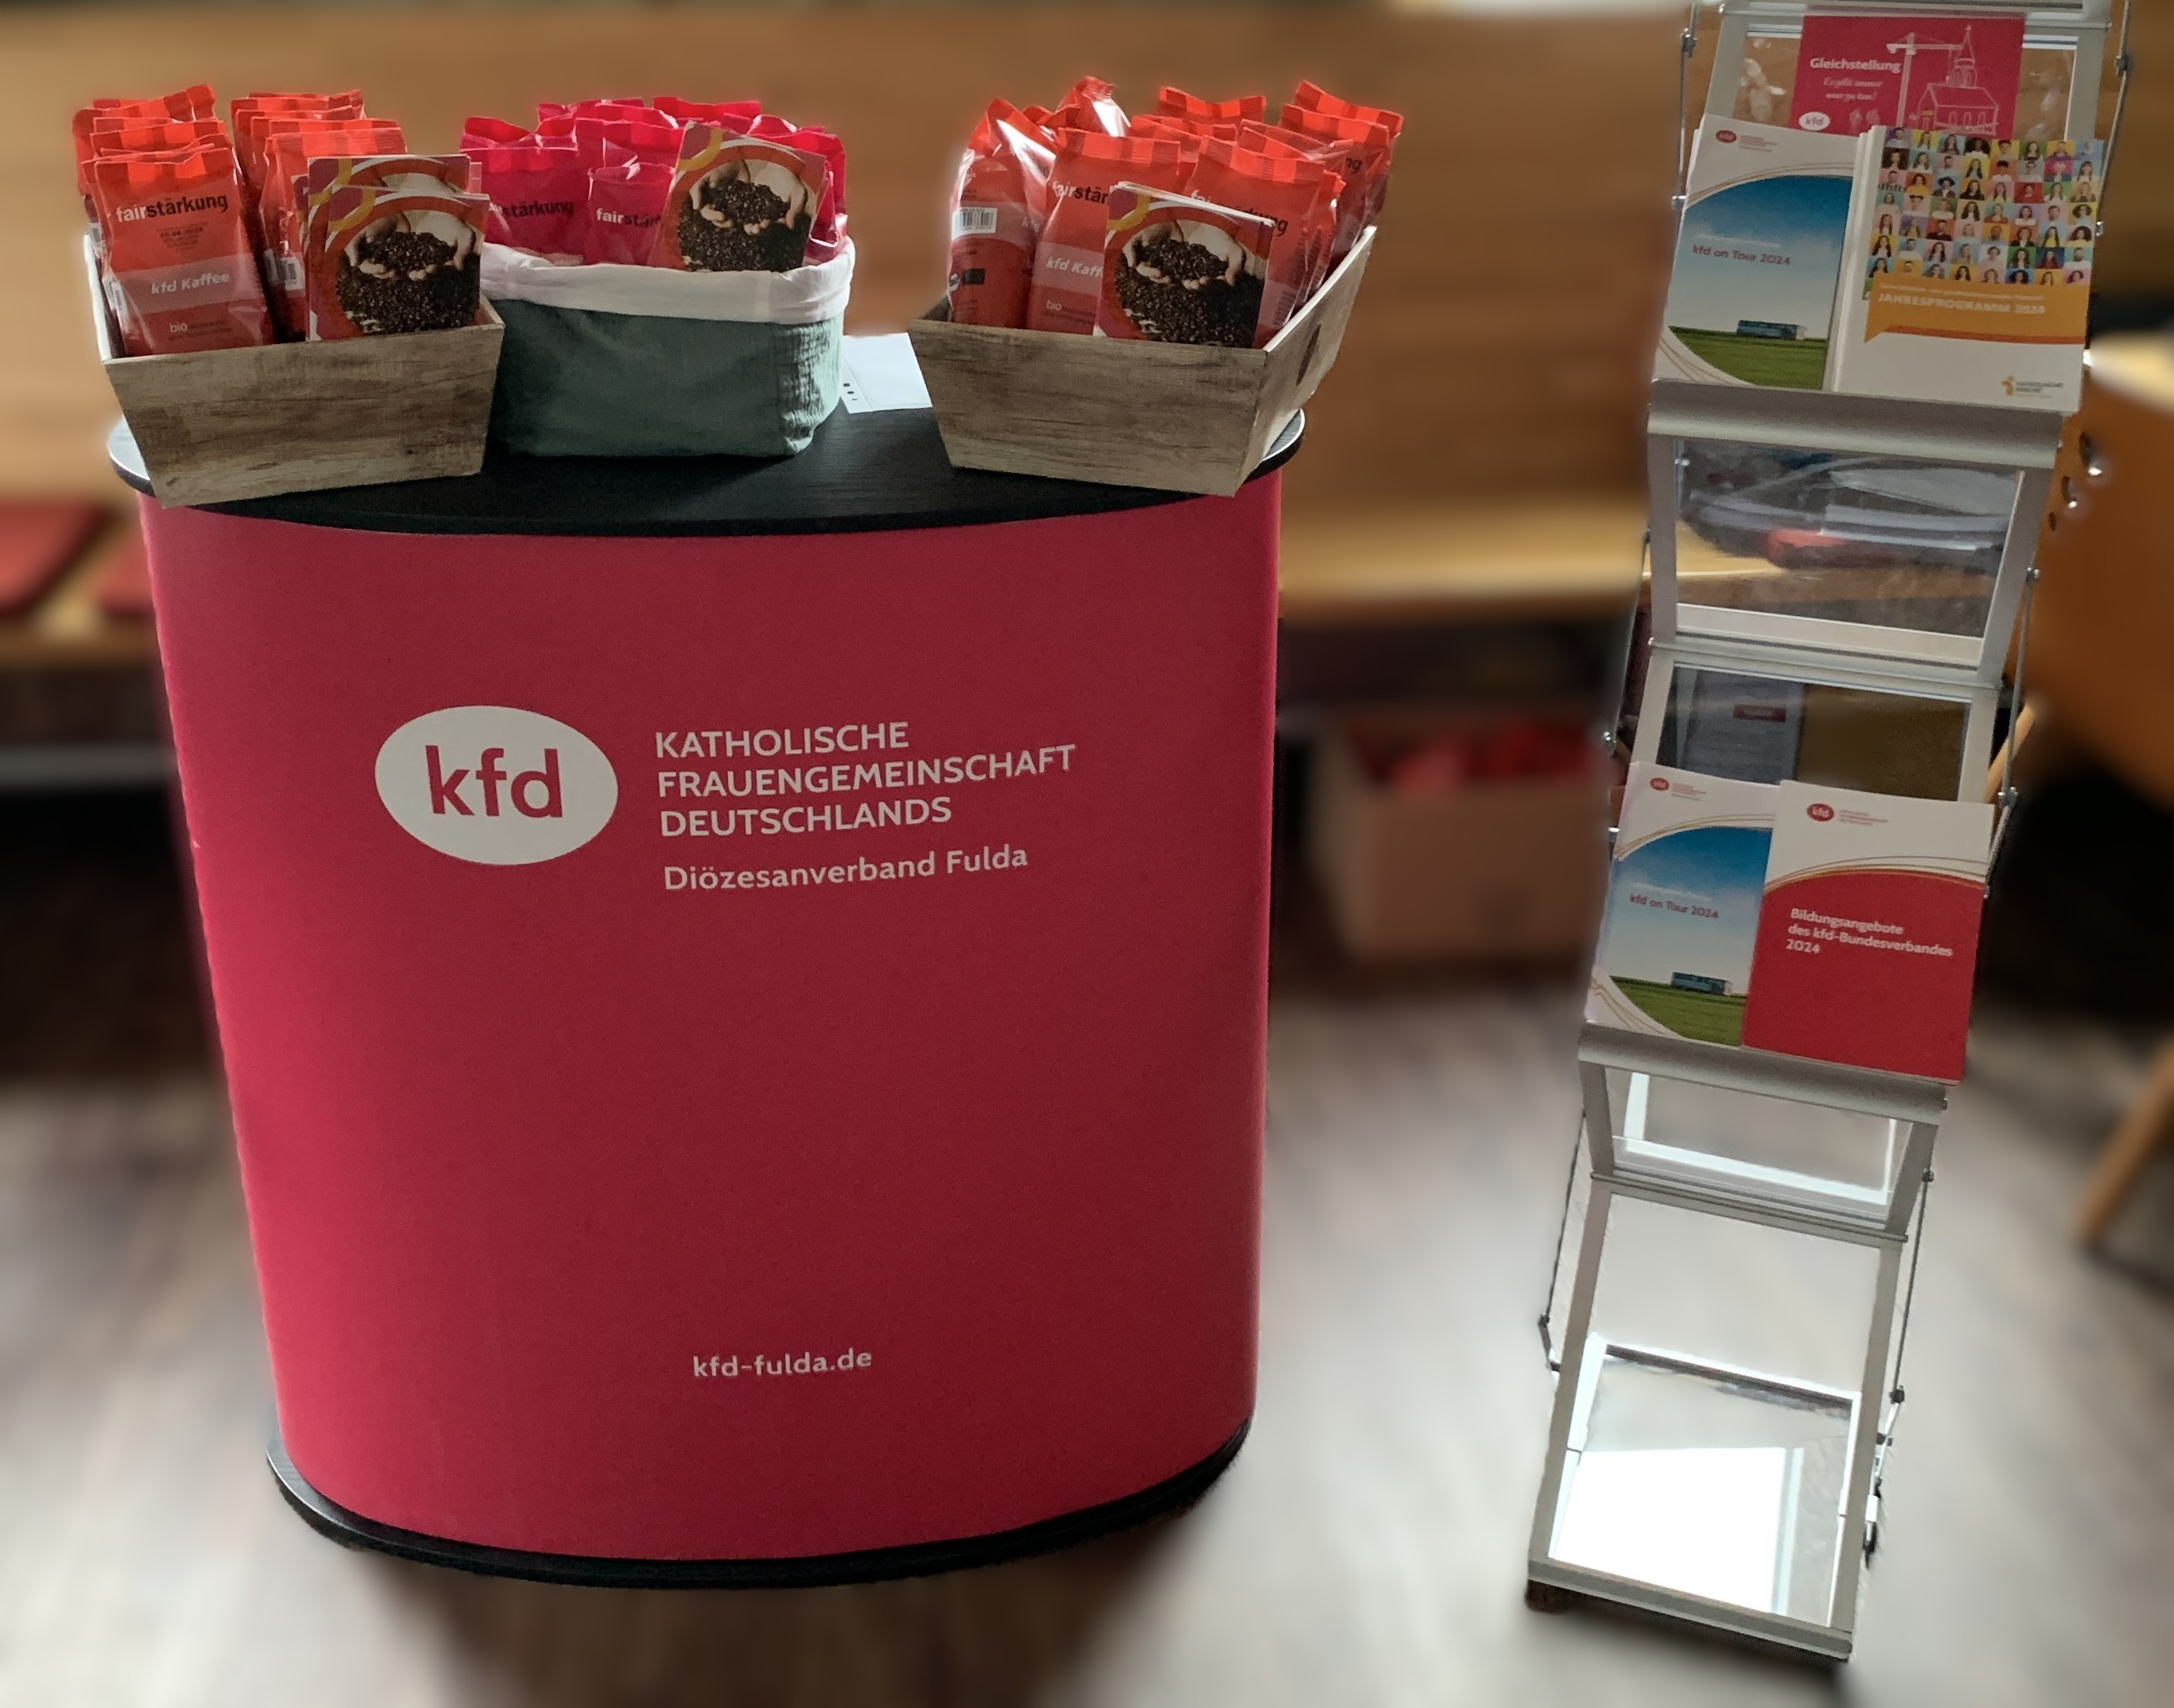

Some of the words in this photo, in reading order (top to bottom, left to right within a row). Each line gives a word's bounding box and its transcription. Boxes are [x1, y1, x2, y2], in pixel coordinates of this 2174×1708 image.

[1810, 58, 1901, 74] Gleichstellung
[1805, 117, 1824, 125] kfd
[1052, 181, 1109, 205] fairstär
[116, 195, 228, 223] fairstärkung
[596, 208, 662, 228] fairstär
[1046, 257, 1070, 271] kfd
[1071, 262, 1103, 277] Kaff
[1692, 244, 1711, 256] kfd
[1714, 249, 1728, 258] on
[1733, 250, 1757, 261] Tour
[1760, 253, 1791, 265] 2024
[152, 279, 176, 294] kfd
[182, 273, 230, 291] Kaffee
[1878, 293, 2011, 313] JAHRESPROGRAMM
[170, 323, 188, 333] bio
[655, 721, 909, 758] KATHOLISCHE
[425, 744, 563, 819] kfd
[658, 744, 1076, 798] FRAUENGEMEINSCHAFT
[661, 796, 952, 837] DEUTSCHLANDS
[664, 850, 935, 890] Diözesanverband
[946, 843, 1028, 874] Fulda
[1629, 893, 1647, 905] kfd
[1649, 899, 1662, 908] on
[1666, 900, 1689, 913] Tour
[1691, 905, 1719, 919] 2024
[1790, 908, 1904, 935] Bildungsangebote
[1786, 938, 1821, 954] 2024
[1787, 923, 1811, 937] des
[1812, 927, 1954, 957] kfd-Bundesverbandes
[692, 1347, 872, 1377] kfd-fulda.de
